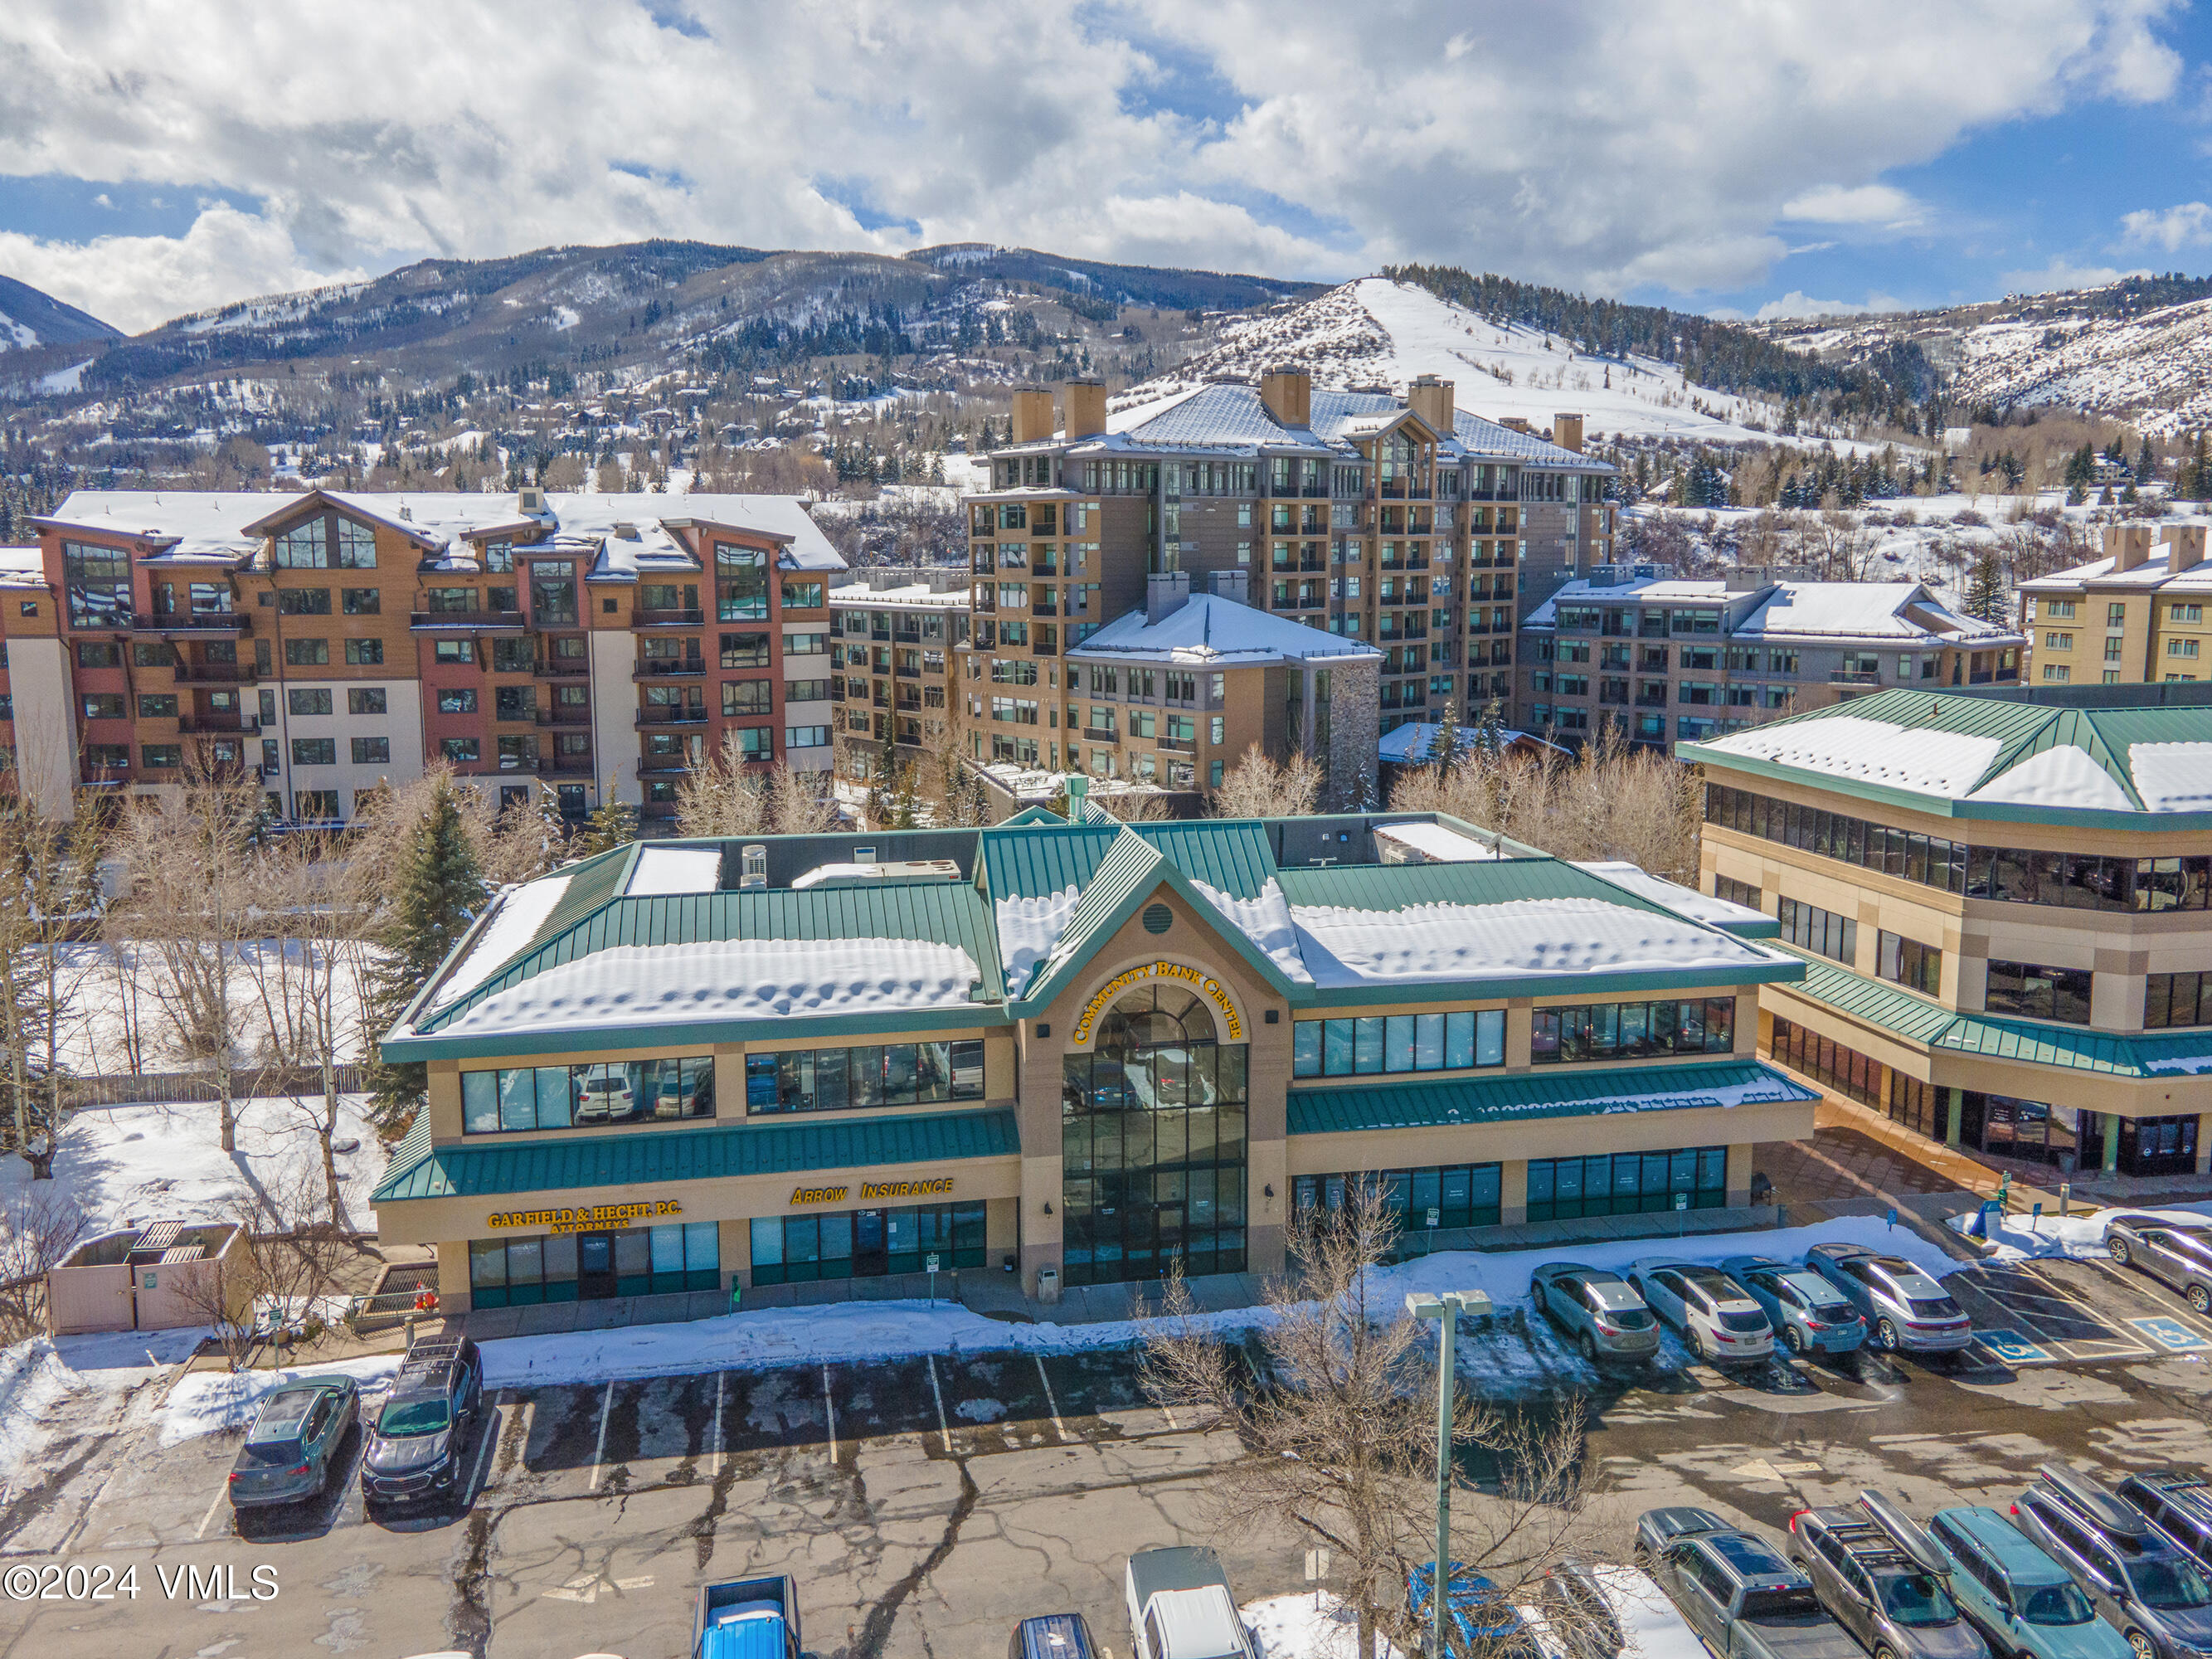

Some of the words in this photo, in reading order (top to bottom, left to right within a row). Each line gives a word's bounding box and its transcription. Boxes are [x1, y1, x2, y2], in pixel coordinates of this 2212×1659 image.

[1074, 964, 1152, 1045] COMMUNITY
[1155, 961, 1205, 985] BANK
[1203, 979, 1242, 1040] CENTER
[790, 1186, 848, 1205] ARROW
[860, 1178, 954, 1200] INSURANCE
[488, 1208, 573, 1228] GARFIELD
[576, 1207, 589, 1222] &
[592, 1202, 653, 1220] HECHT,
[655, 1199, 683, 1215] P.C.
[550, 1219, 629, 1234] ATTORNEYS
